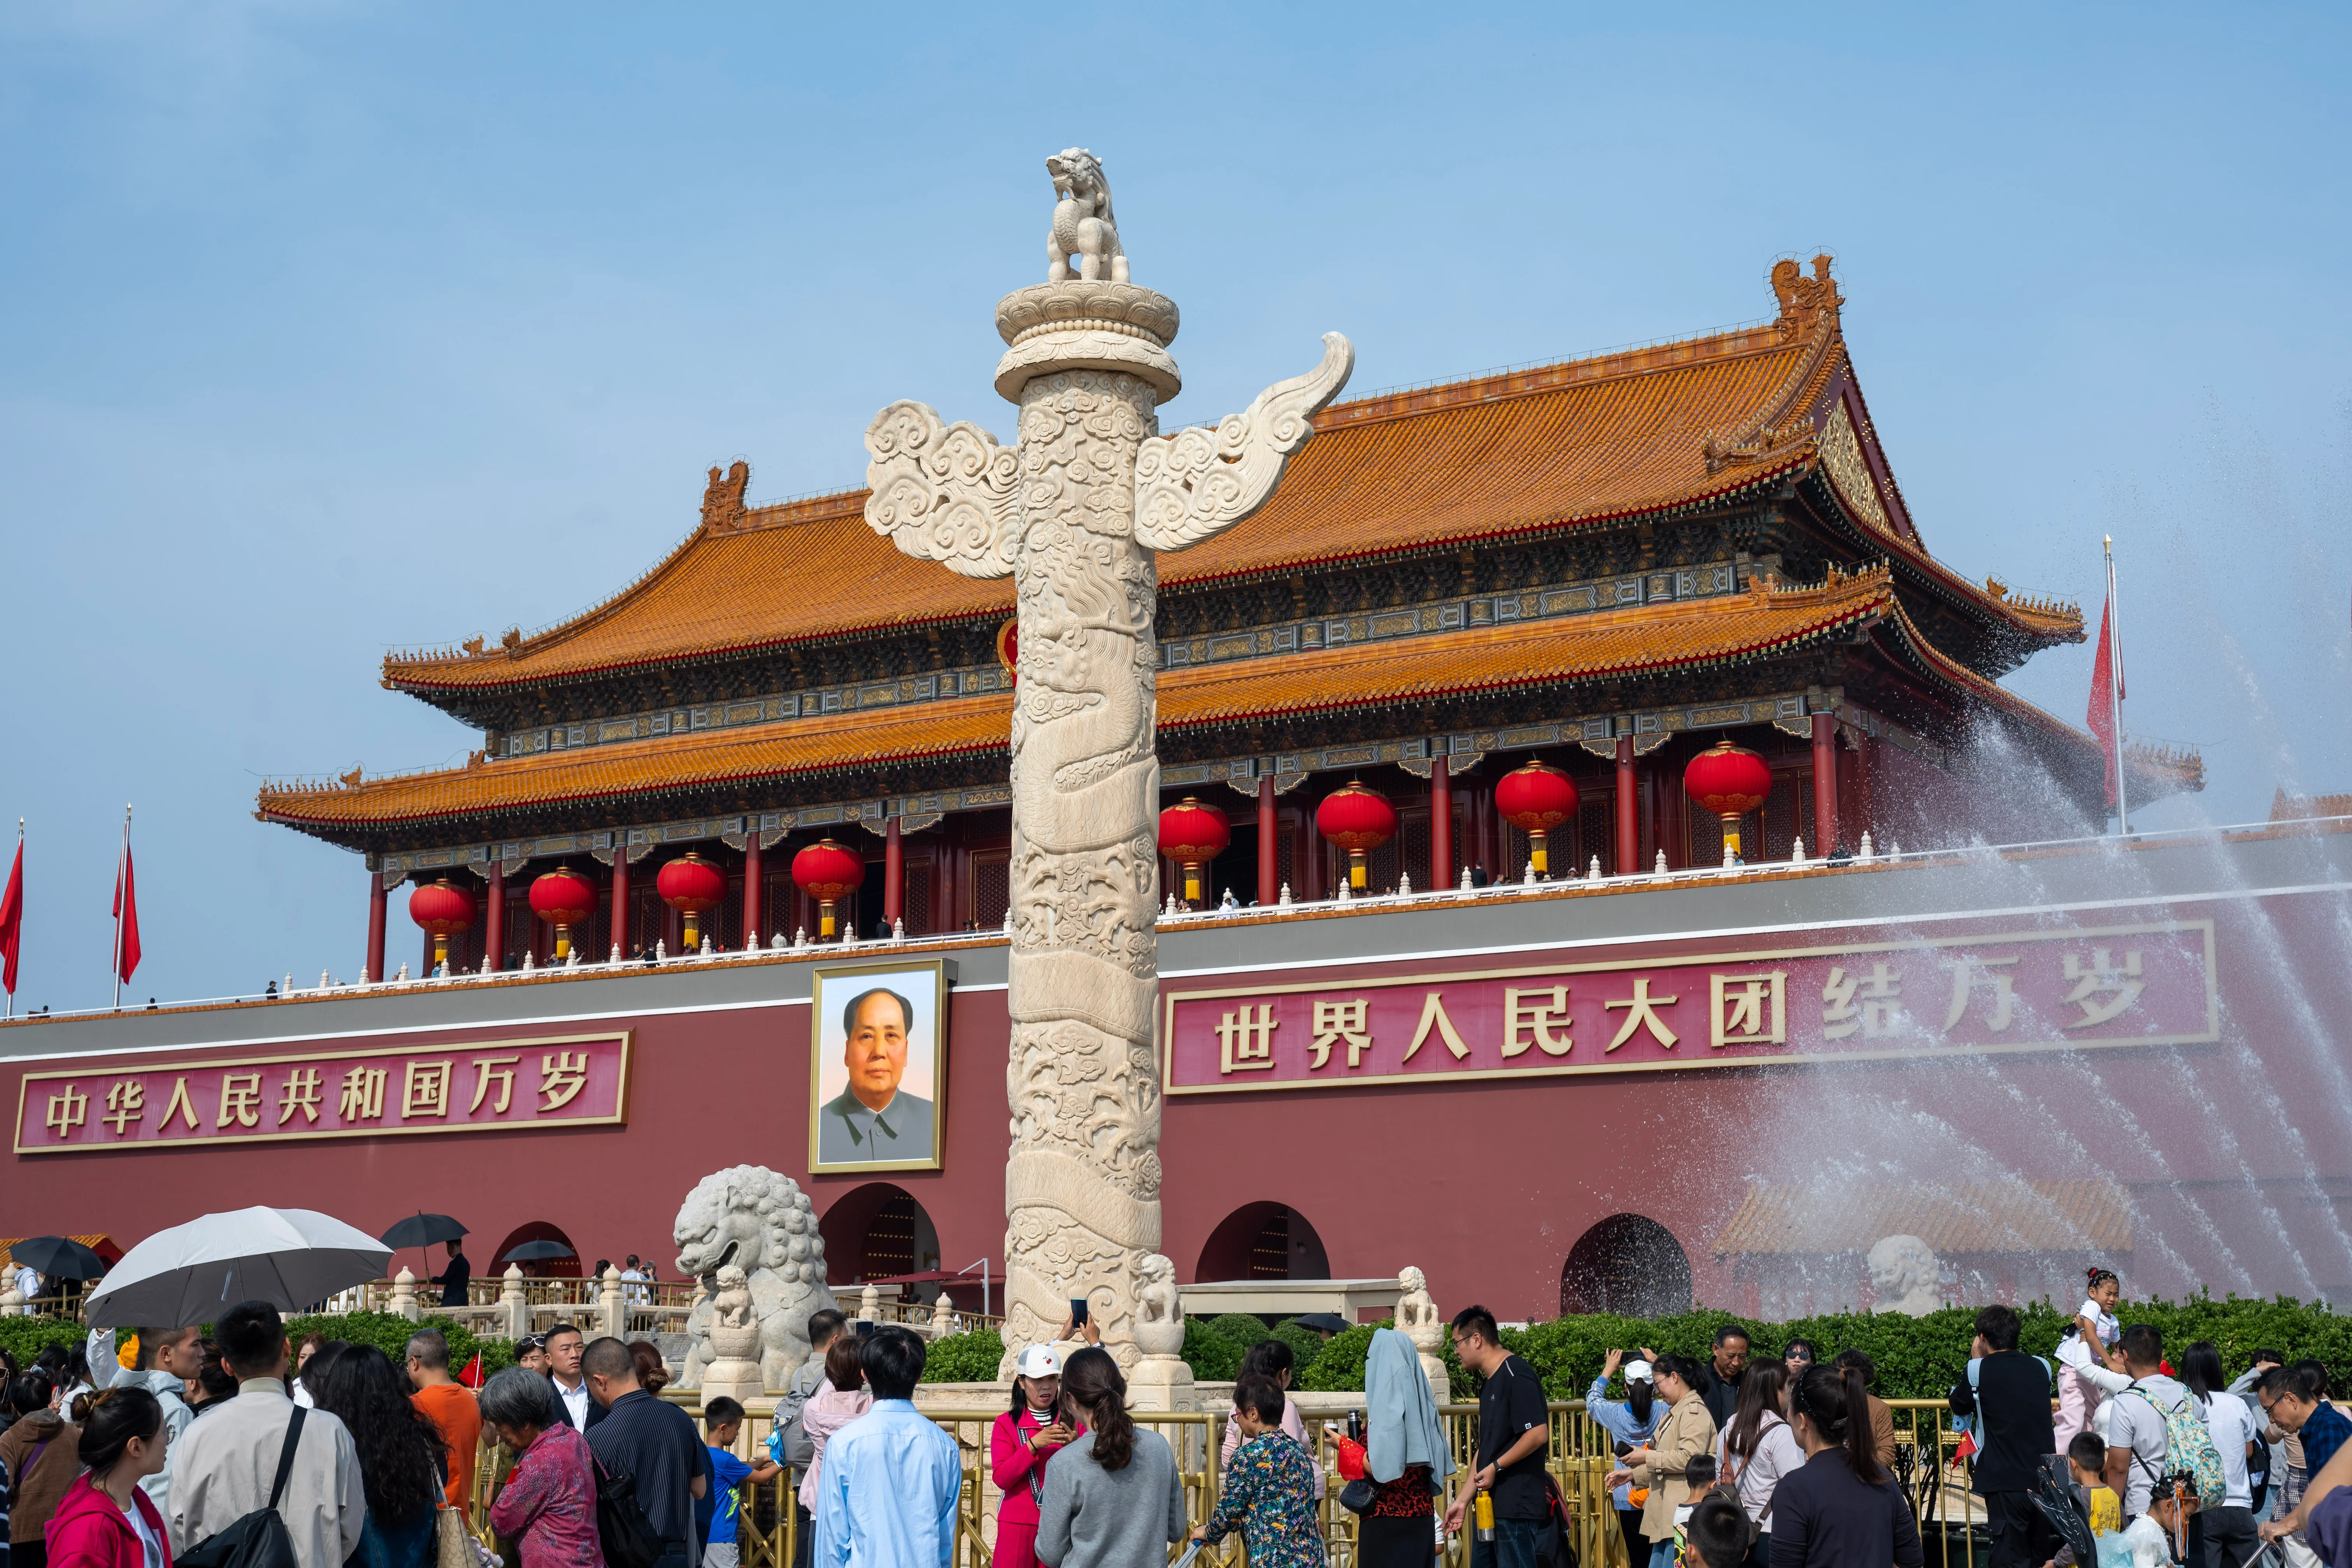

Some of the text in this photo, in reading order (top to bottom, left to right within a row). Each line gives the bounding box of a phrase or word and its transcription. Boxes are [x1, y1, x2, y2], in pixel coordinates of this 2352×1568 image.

[1215, 950, 2147, 1074] 世界人民大团结万岁
[46, 1052, 588, 1138] 中华人民共和国万岁
